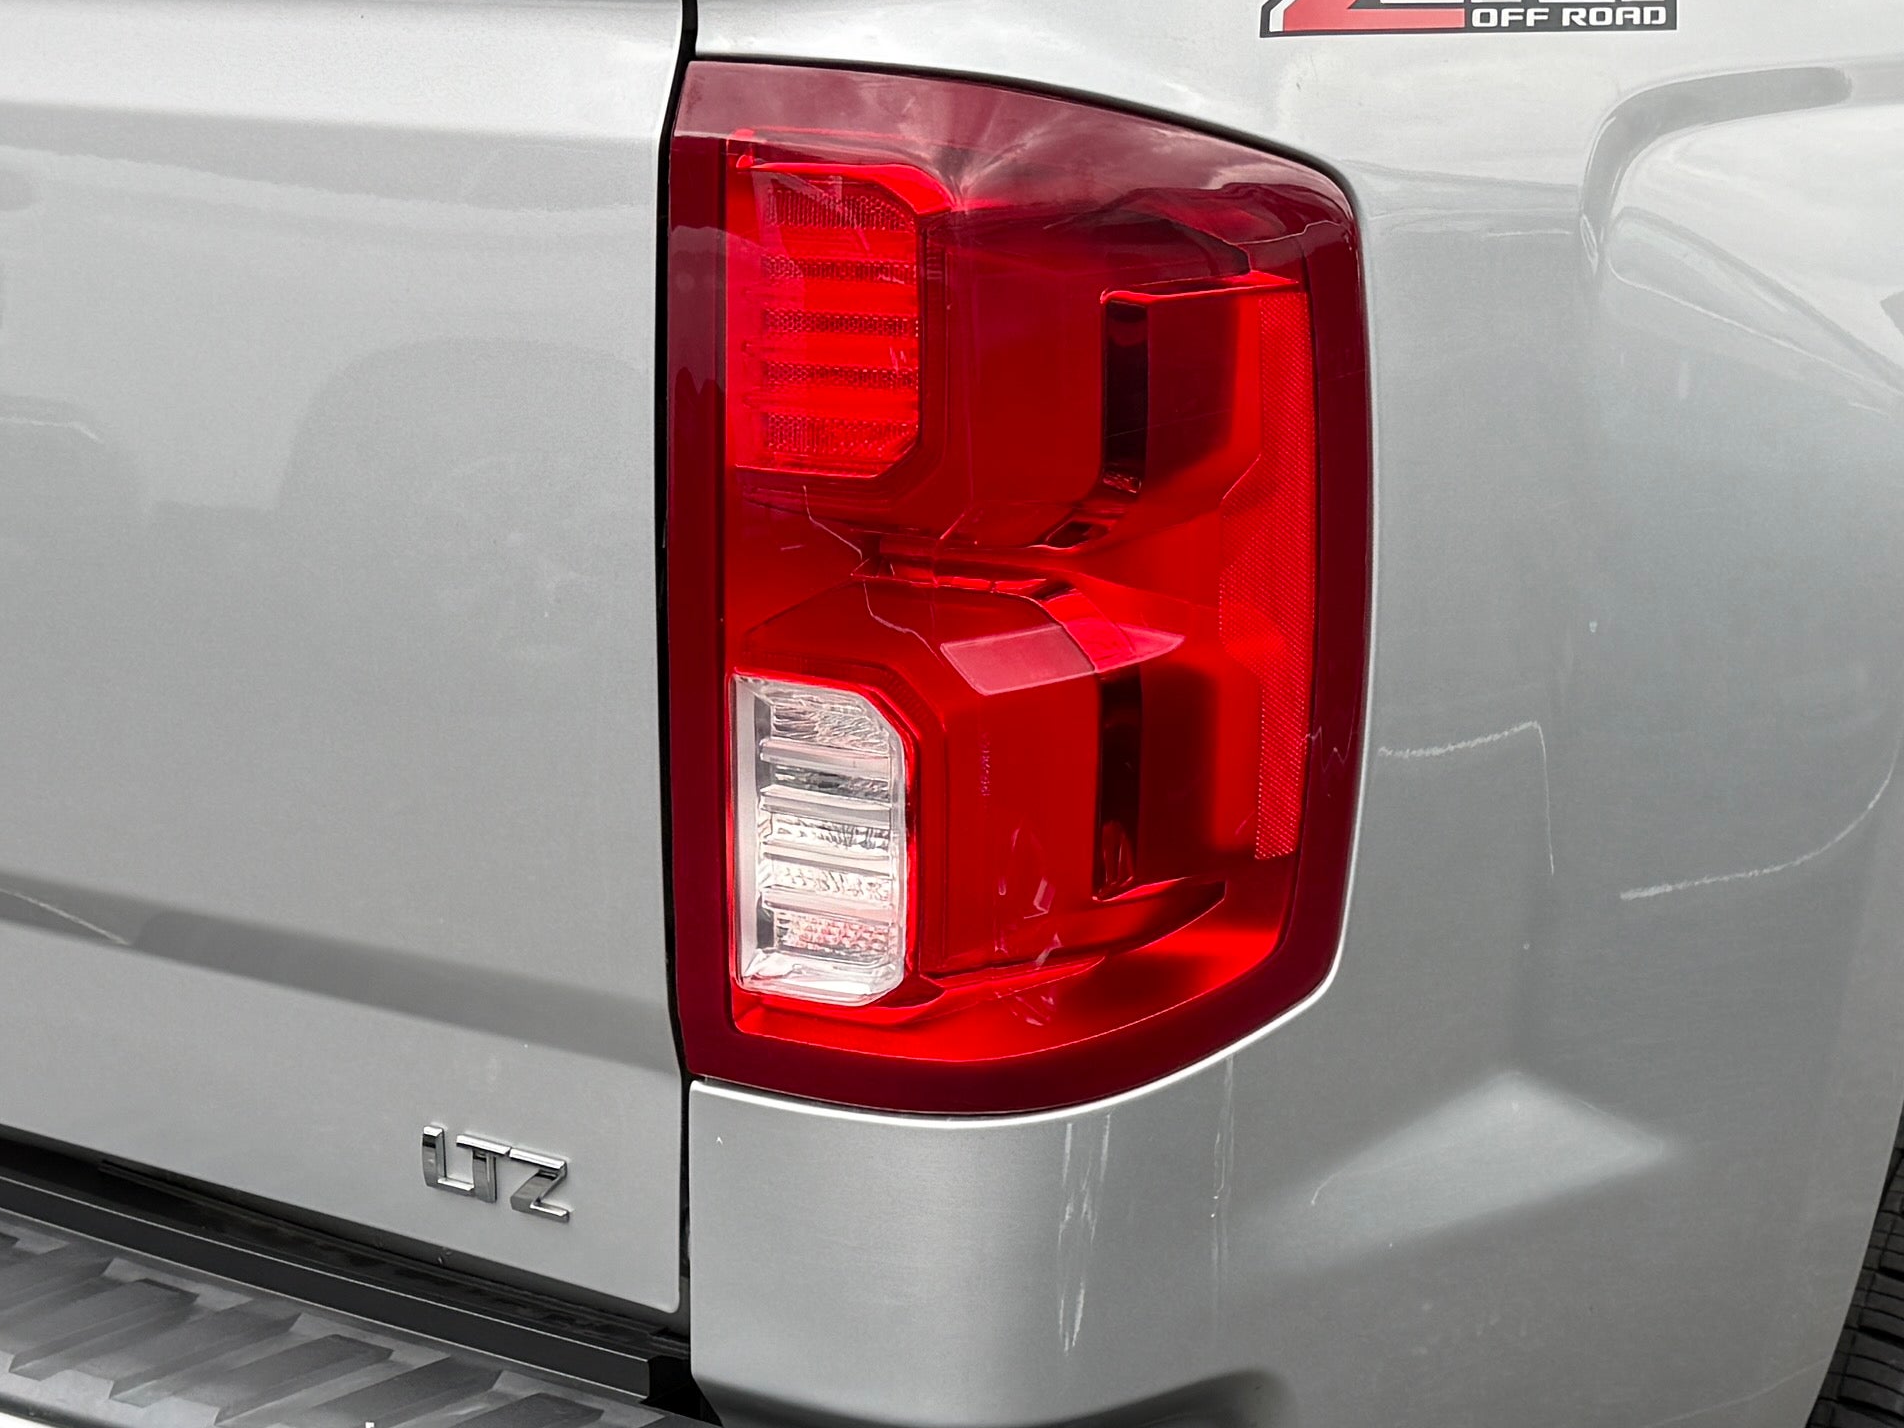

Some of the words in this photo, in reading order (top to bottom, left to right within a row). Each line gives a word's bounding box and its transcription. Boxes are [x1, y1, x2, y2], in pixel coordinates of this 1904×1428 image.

[1471, 7, 1549, 28] OFF
[1561, 6, 1667, 26] ROAD
[421, 1124, 571, 1223] LTZ
